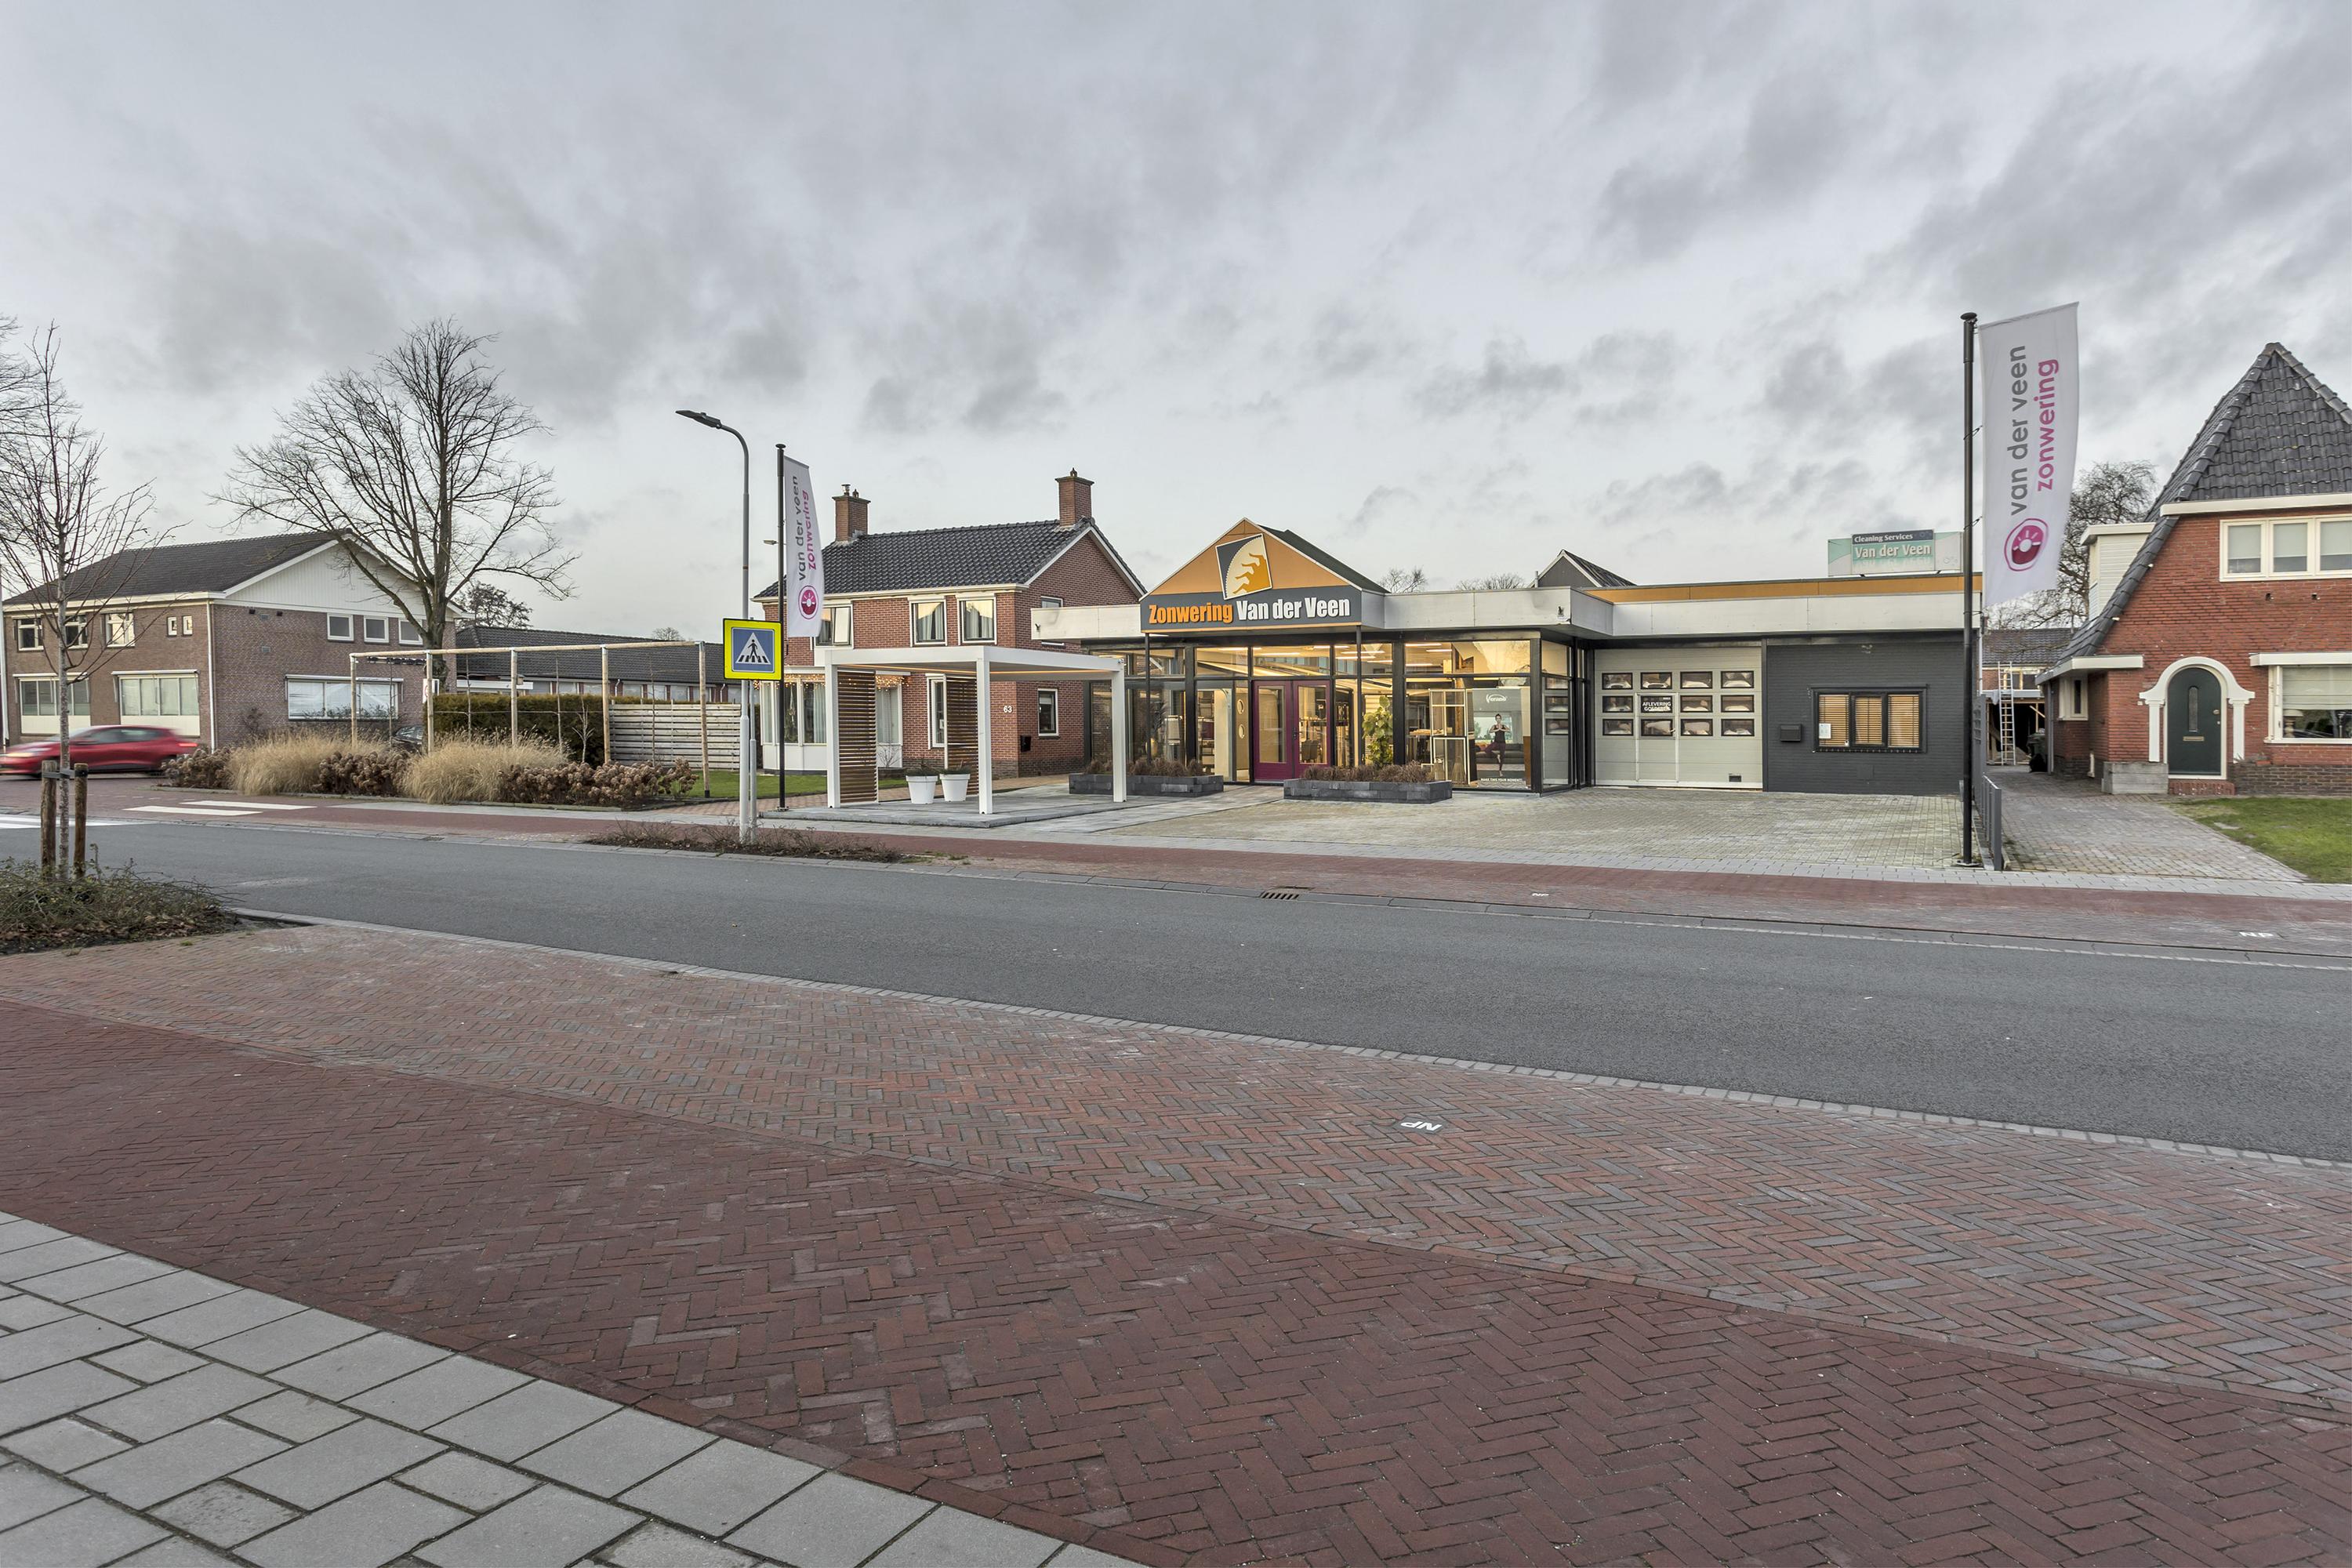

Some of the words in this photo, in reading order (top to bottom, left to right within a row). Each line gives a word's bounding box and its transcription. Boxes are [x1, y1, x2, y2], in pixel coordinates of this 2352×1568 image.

[2009, 346, 2028, 412] veen
[2034, 358, 2060, 492] zonwering
[2007, 419, 2029, 460] der
[2010, 467, 2028, 516] van
[795, 520, 804, 546] der
[1856, 547, 1876, 558] Van
[1880, 544, 1899, 557] der
[1902, 544, 1931, 556] Veen
[1149, 602, 1233, 624] Zonwering
[1236, 600, 1269, 621] Van
[1272, 598, 1302, 619] der
[1305, 597, 1350, 618] Veen
[1004, 705, 1013, 713] 63
[1400, 1121, 1443, 1131] NP
